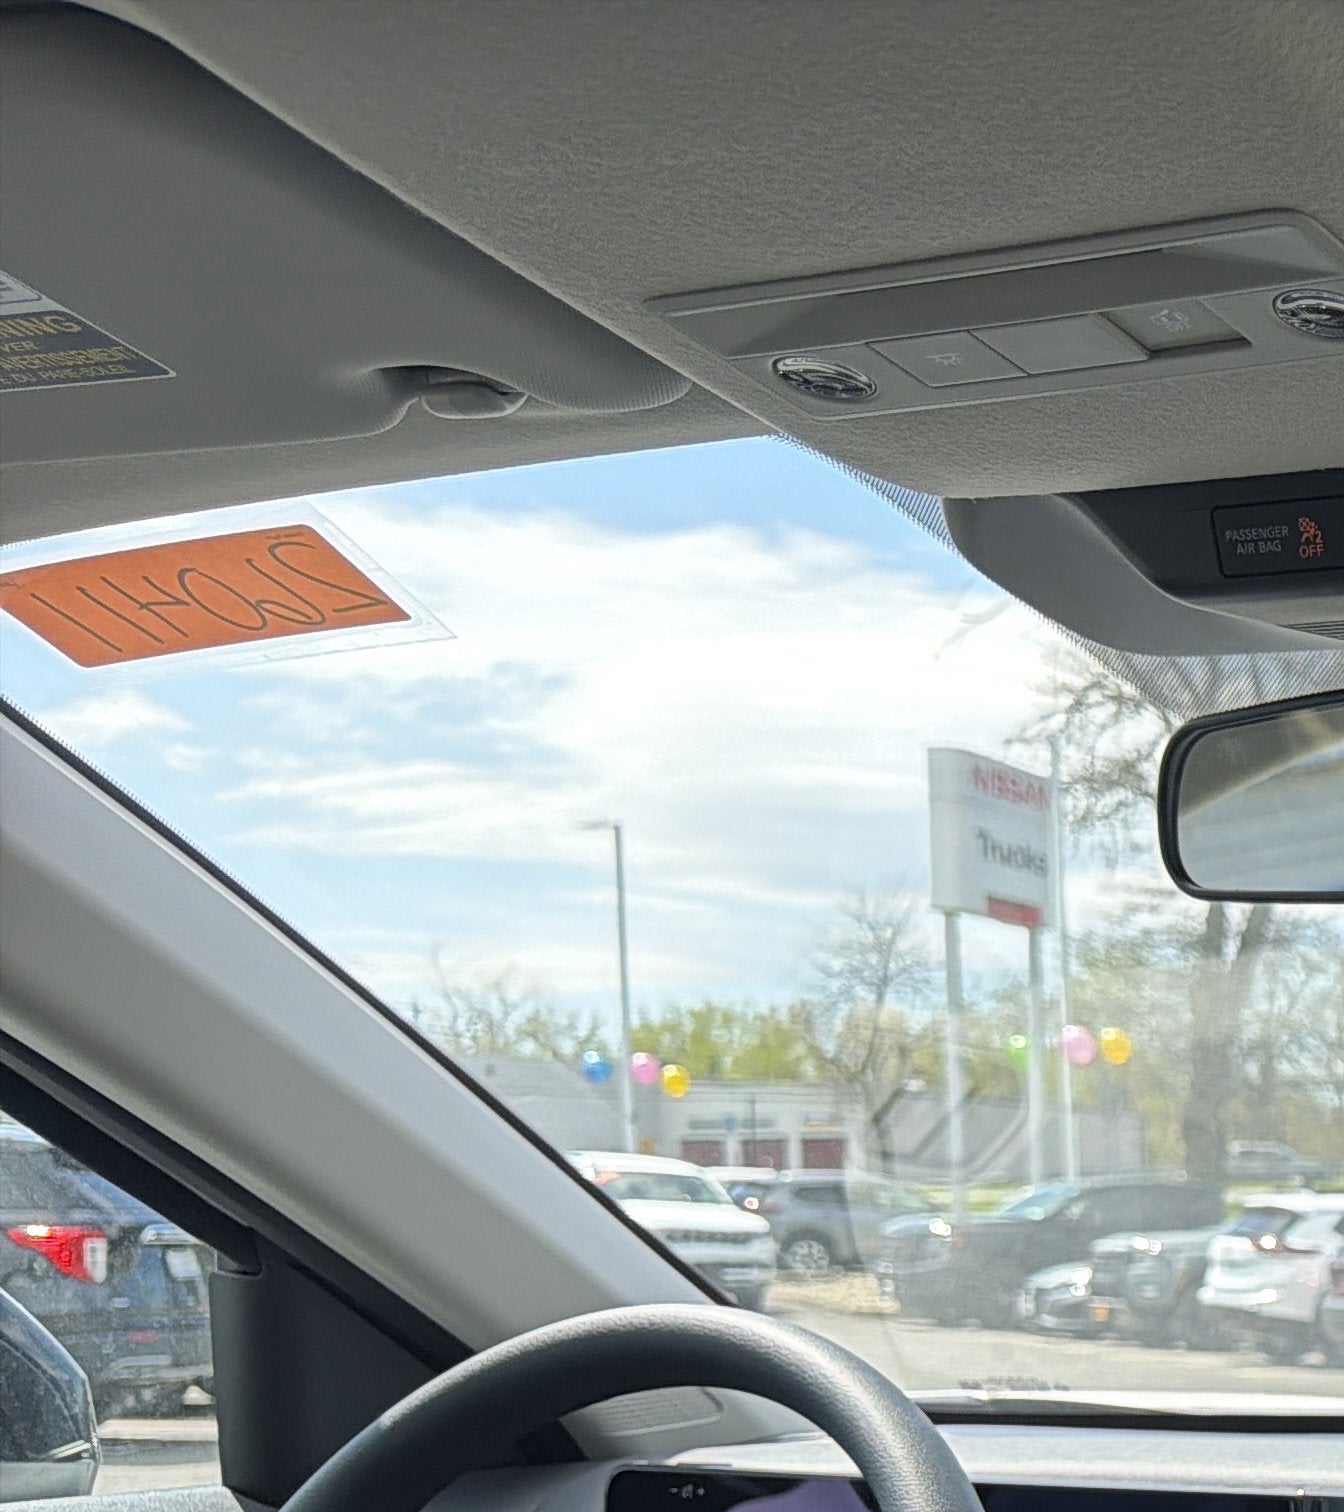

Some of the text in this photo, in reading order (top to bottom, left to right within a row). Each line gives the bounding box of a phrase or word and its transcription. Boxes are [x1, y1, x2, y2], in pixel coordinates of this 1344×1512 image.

[1225, 525, 1289, 543] PASSENGER
[1236, 540, 1282, 555] AIR BAG
[1300, 543, 1325, 559] OFF
